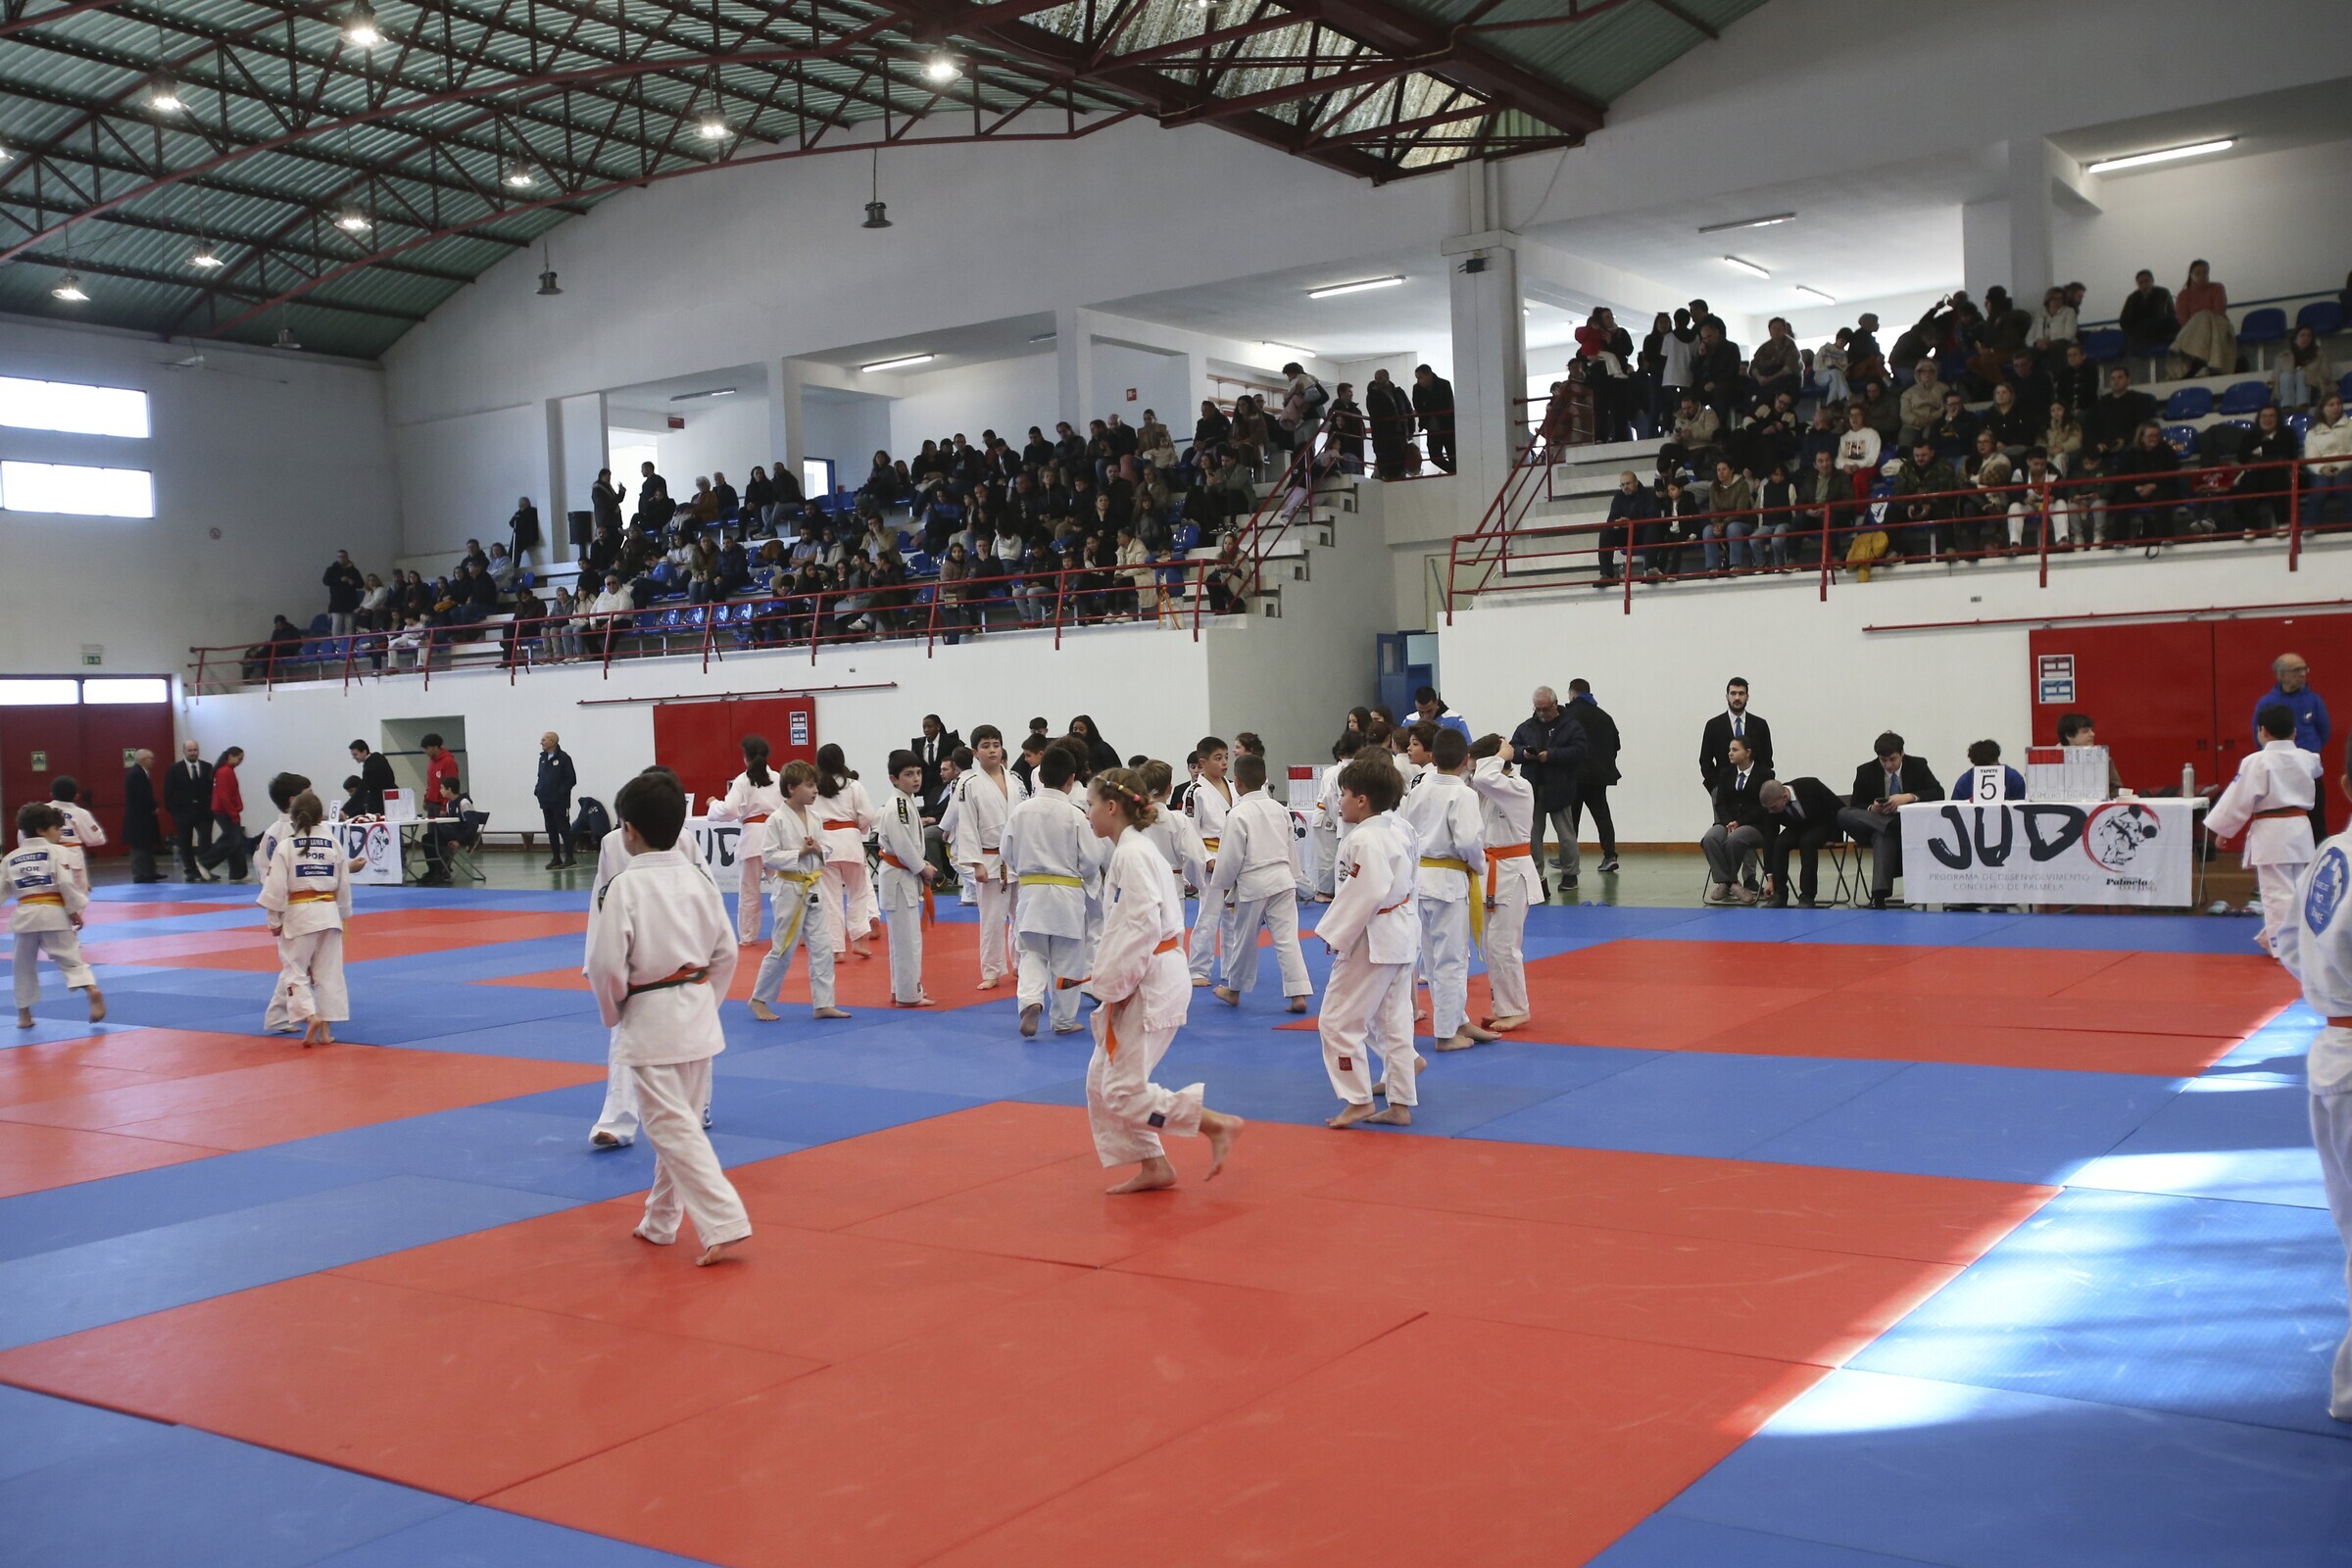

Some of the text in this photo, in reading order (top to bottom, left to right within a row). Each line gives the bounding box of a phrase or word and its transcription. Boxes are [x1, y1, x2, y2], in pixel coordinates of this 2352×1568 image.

[1980, 774, 1997, 801] 5
[330, 806, 338, 819] 8
[306, 852, 325, 860] POR
